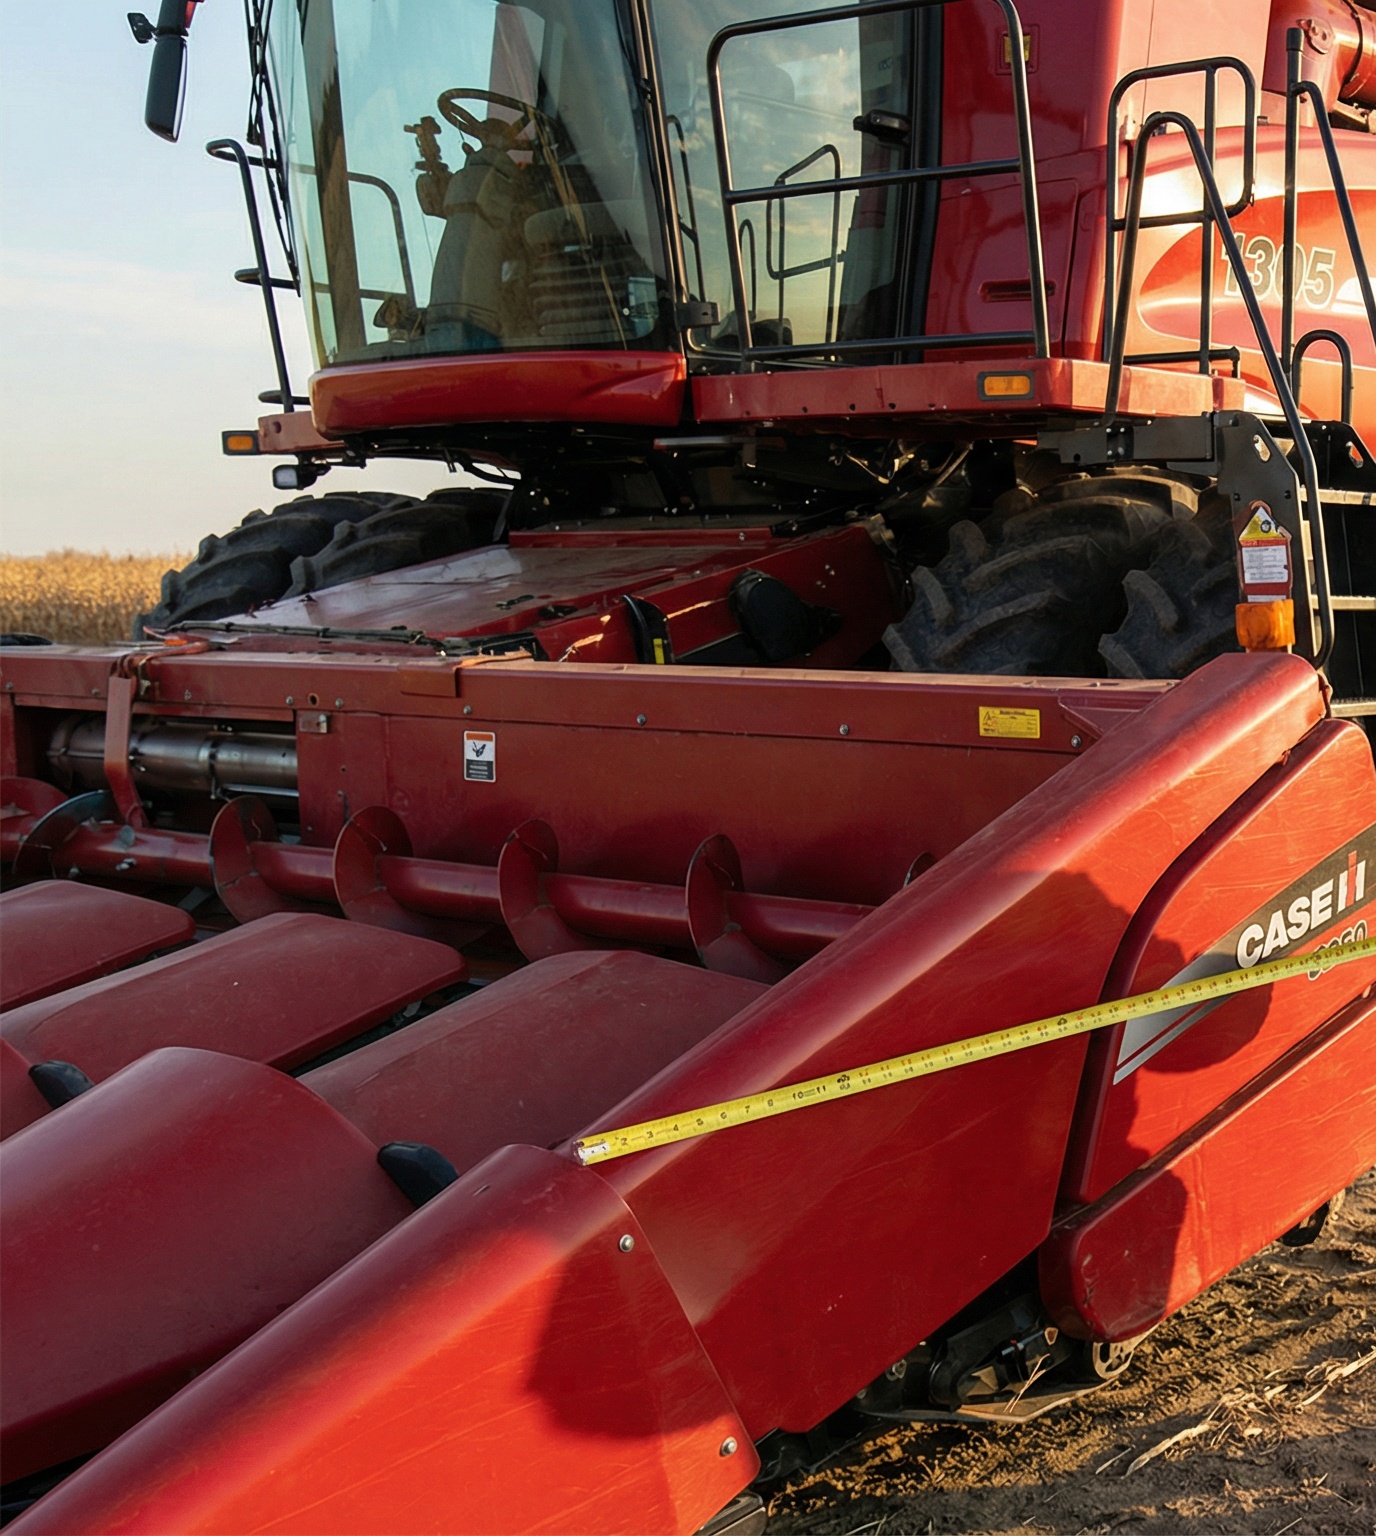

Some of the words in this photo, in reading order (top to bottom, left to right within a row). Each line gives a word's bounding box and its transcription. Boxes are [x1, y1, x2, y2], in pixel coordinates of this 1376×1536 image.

[1237, 878, 1334, 969] CASE
[646, 1130, 654, 1139] 3
[673, 1123, 679, 1132] 4
[744, 1104, 751, 1114] 7
